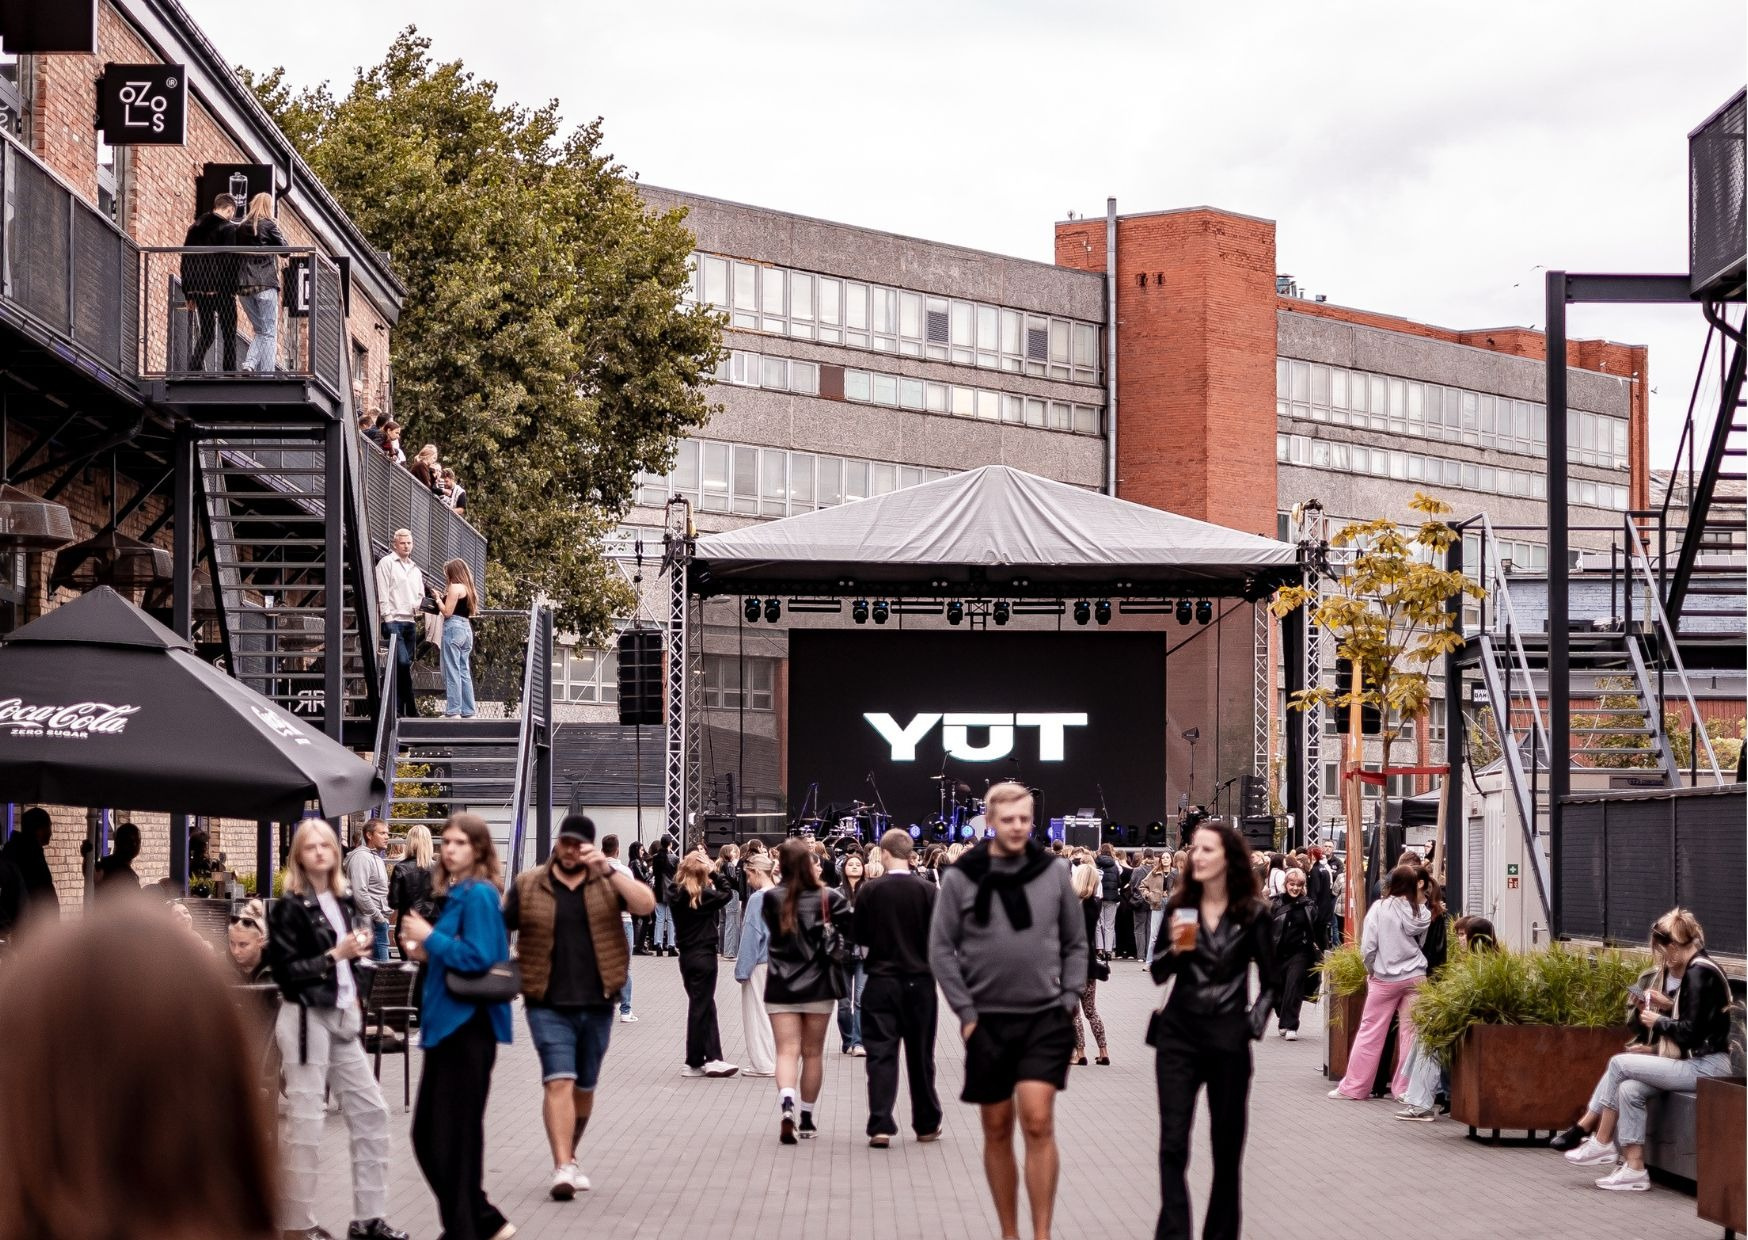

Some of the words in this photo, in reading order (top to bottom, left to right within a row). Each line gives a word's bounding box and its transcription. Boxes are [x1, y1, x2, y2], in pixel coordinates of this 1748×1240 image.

[10, 728, 44, 737] ZERO
[46, 729, 89, 739] SUGAR
[863, 712, 1088, 762] YUT
